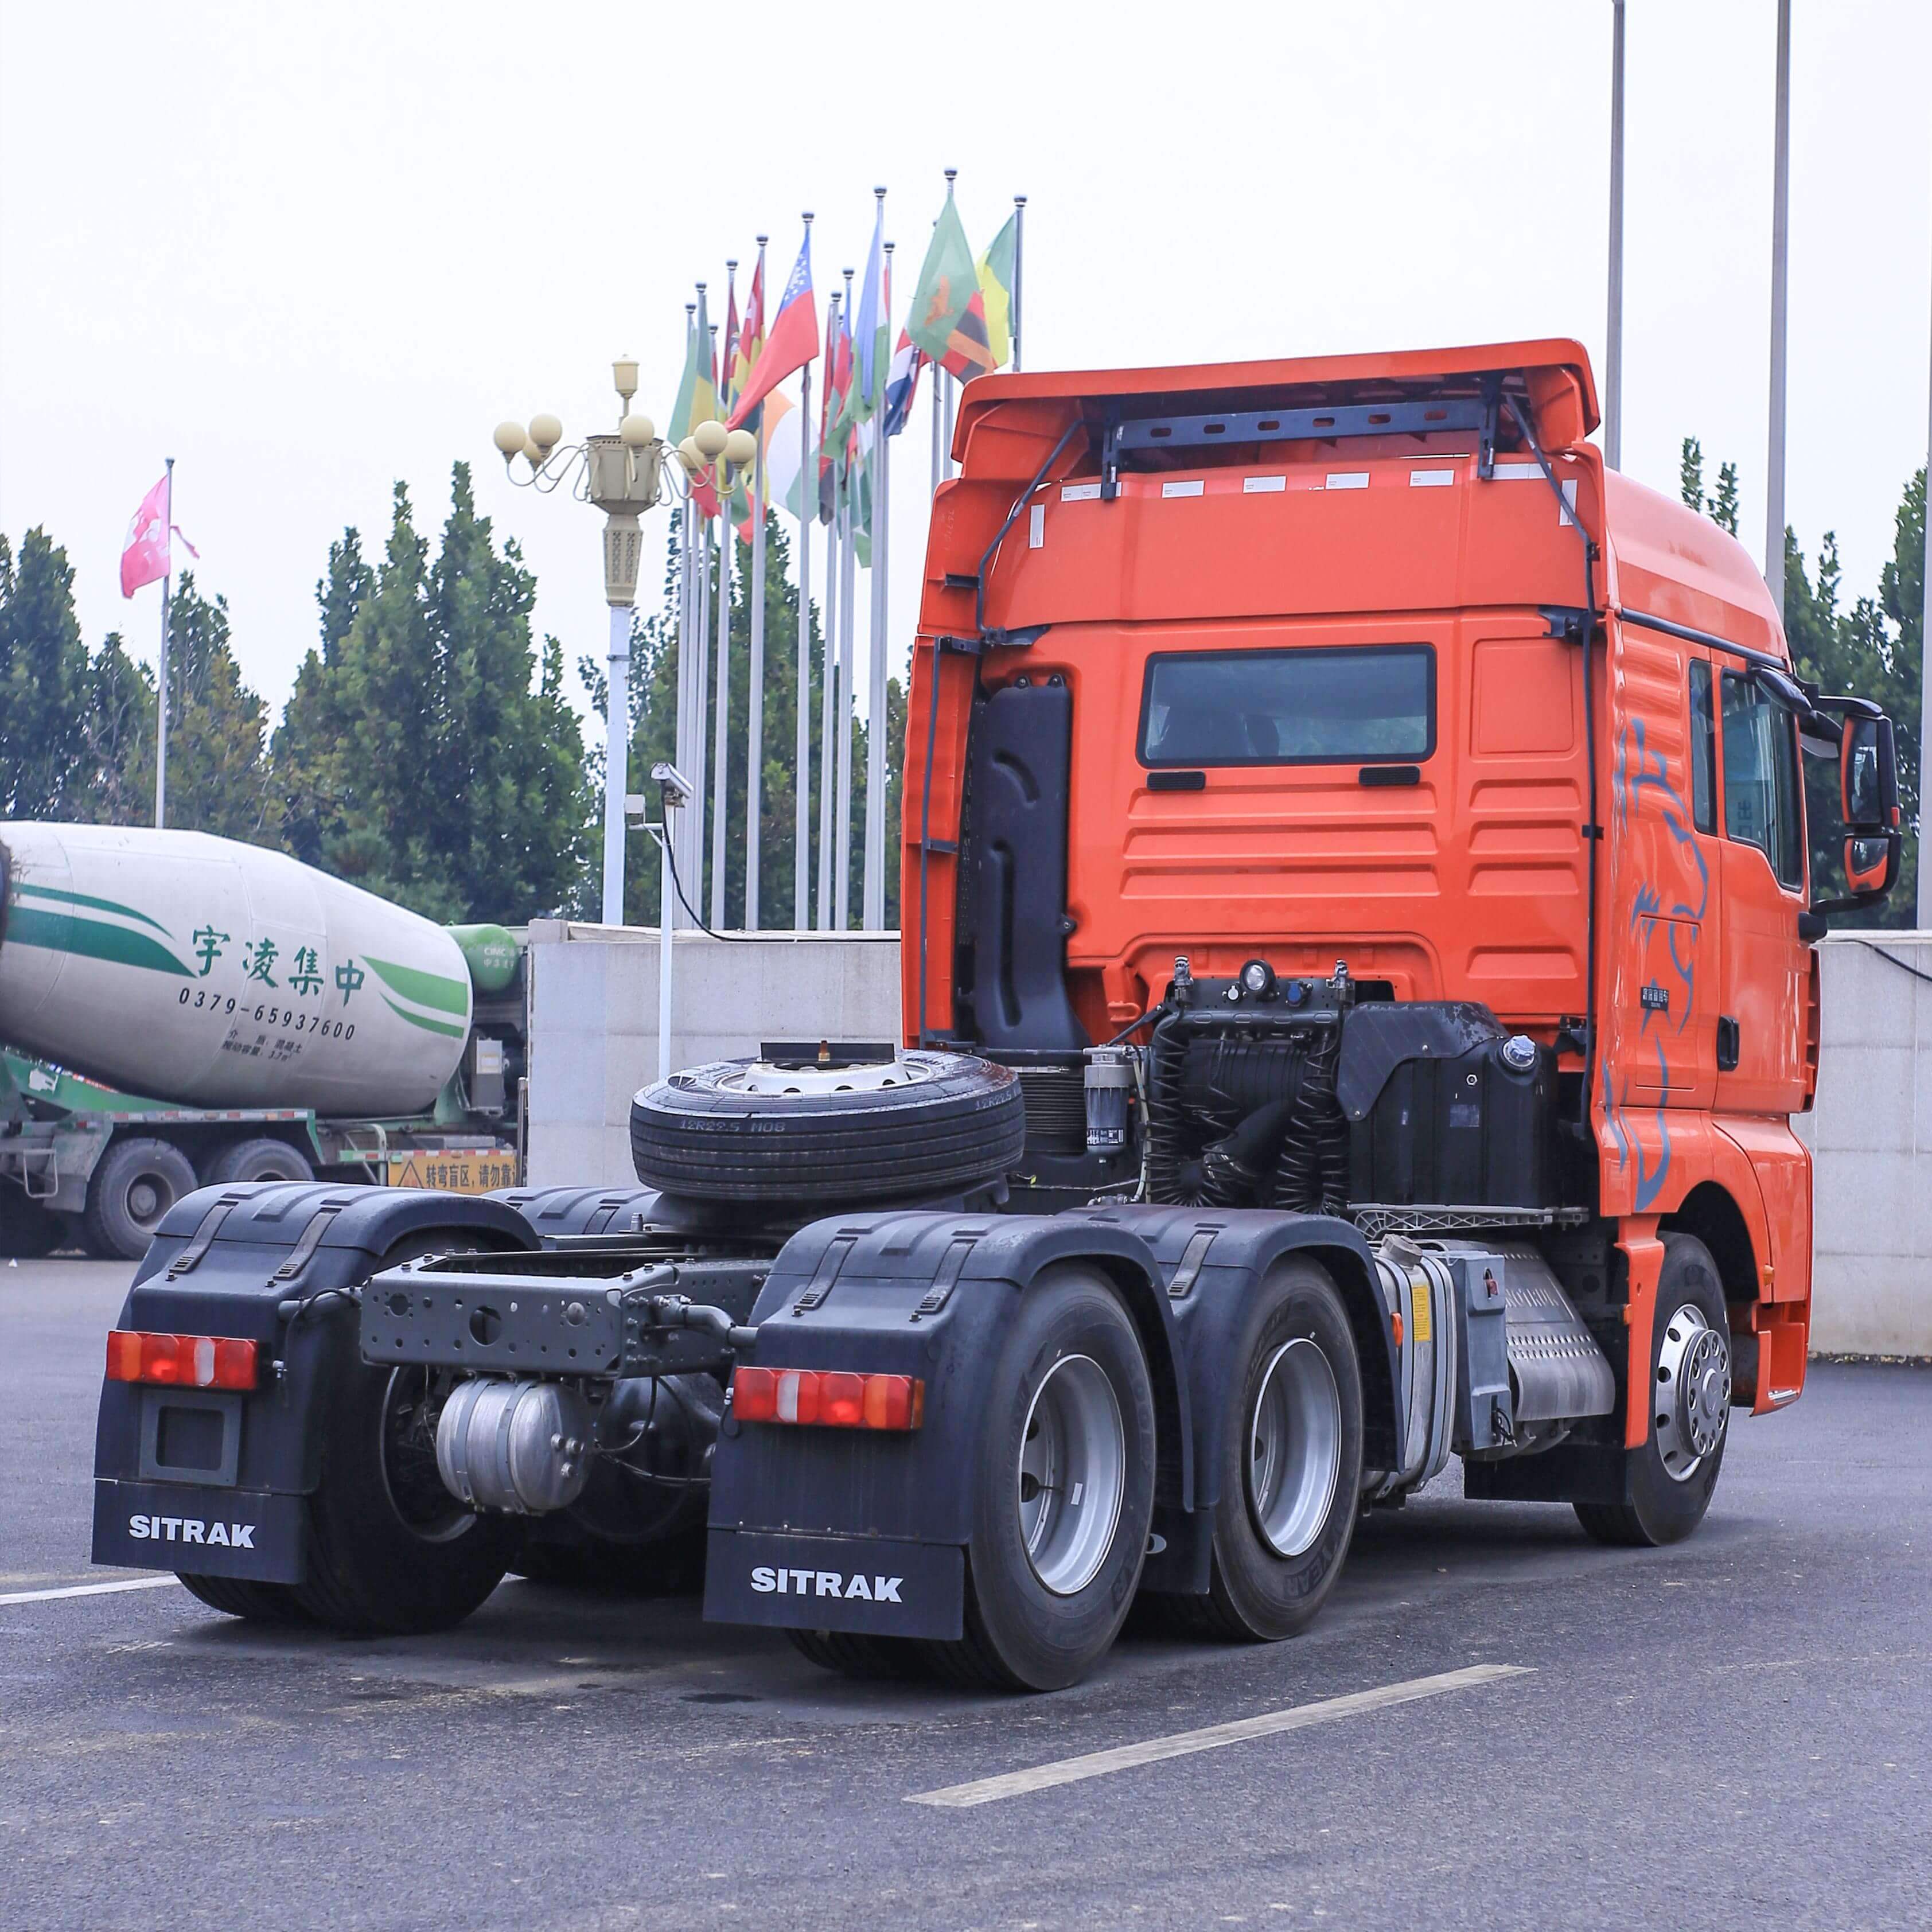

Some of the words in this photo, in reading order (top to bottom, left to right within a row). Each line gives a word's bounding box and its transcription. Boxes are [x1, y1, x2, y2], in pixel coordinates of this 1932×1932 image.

[178, 987, 355, 1040] 0379-65937600
[679, 1119, 741, 1132] 12R22.5
[128, 1514, 256, 1549] SITRAK
[750, 1567, 904, 1603] SITRAK
